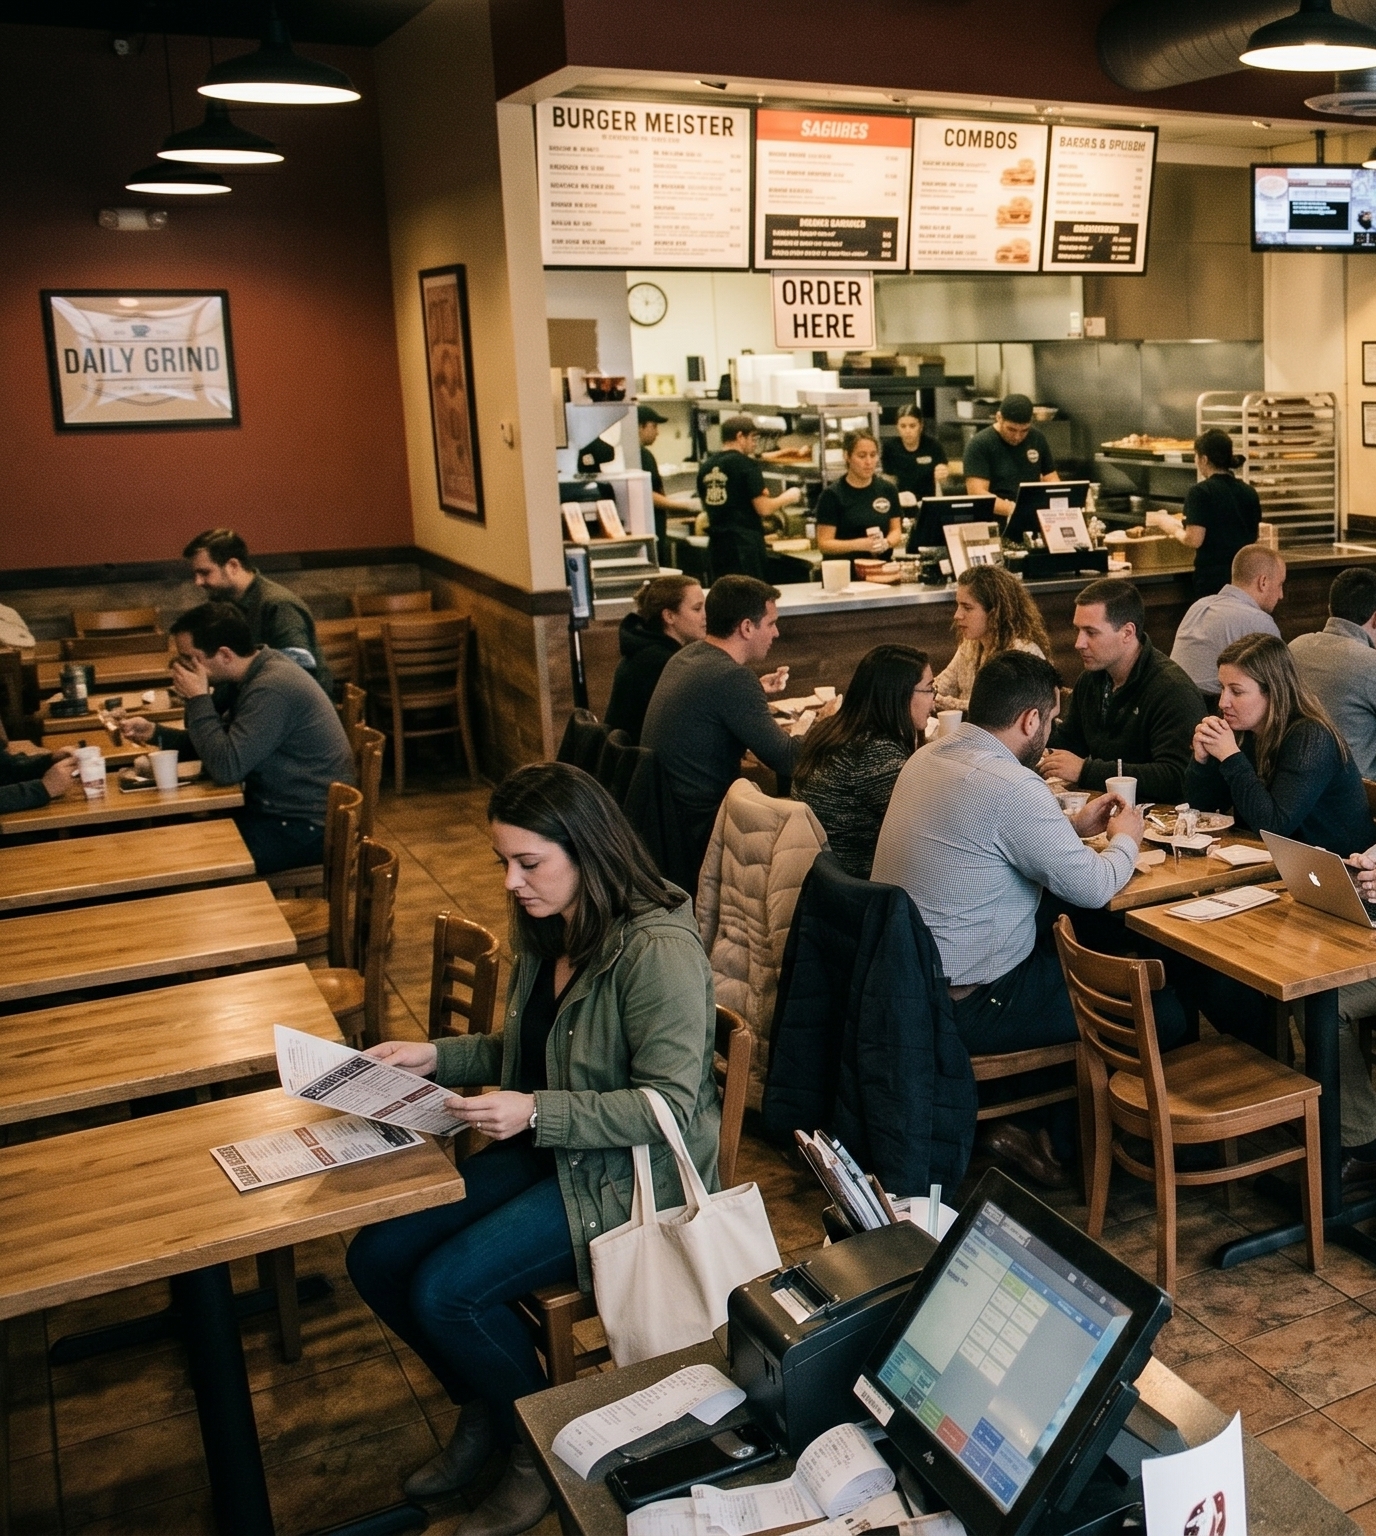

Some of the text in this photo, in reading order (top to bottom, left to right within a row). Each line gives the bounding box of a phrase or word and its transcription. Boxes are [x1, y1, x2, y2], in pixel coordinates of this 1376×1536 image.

[552, 106, 734, 137] BURGER MEISTER
[944, 128, 1018, 149] COMBOS
[782, 279, 862, 306] ORDER
[793, 313, 855, 338] HERE
[64, 346, 220, 374] DAILY GRIND
